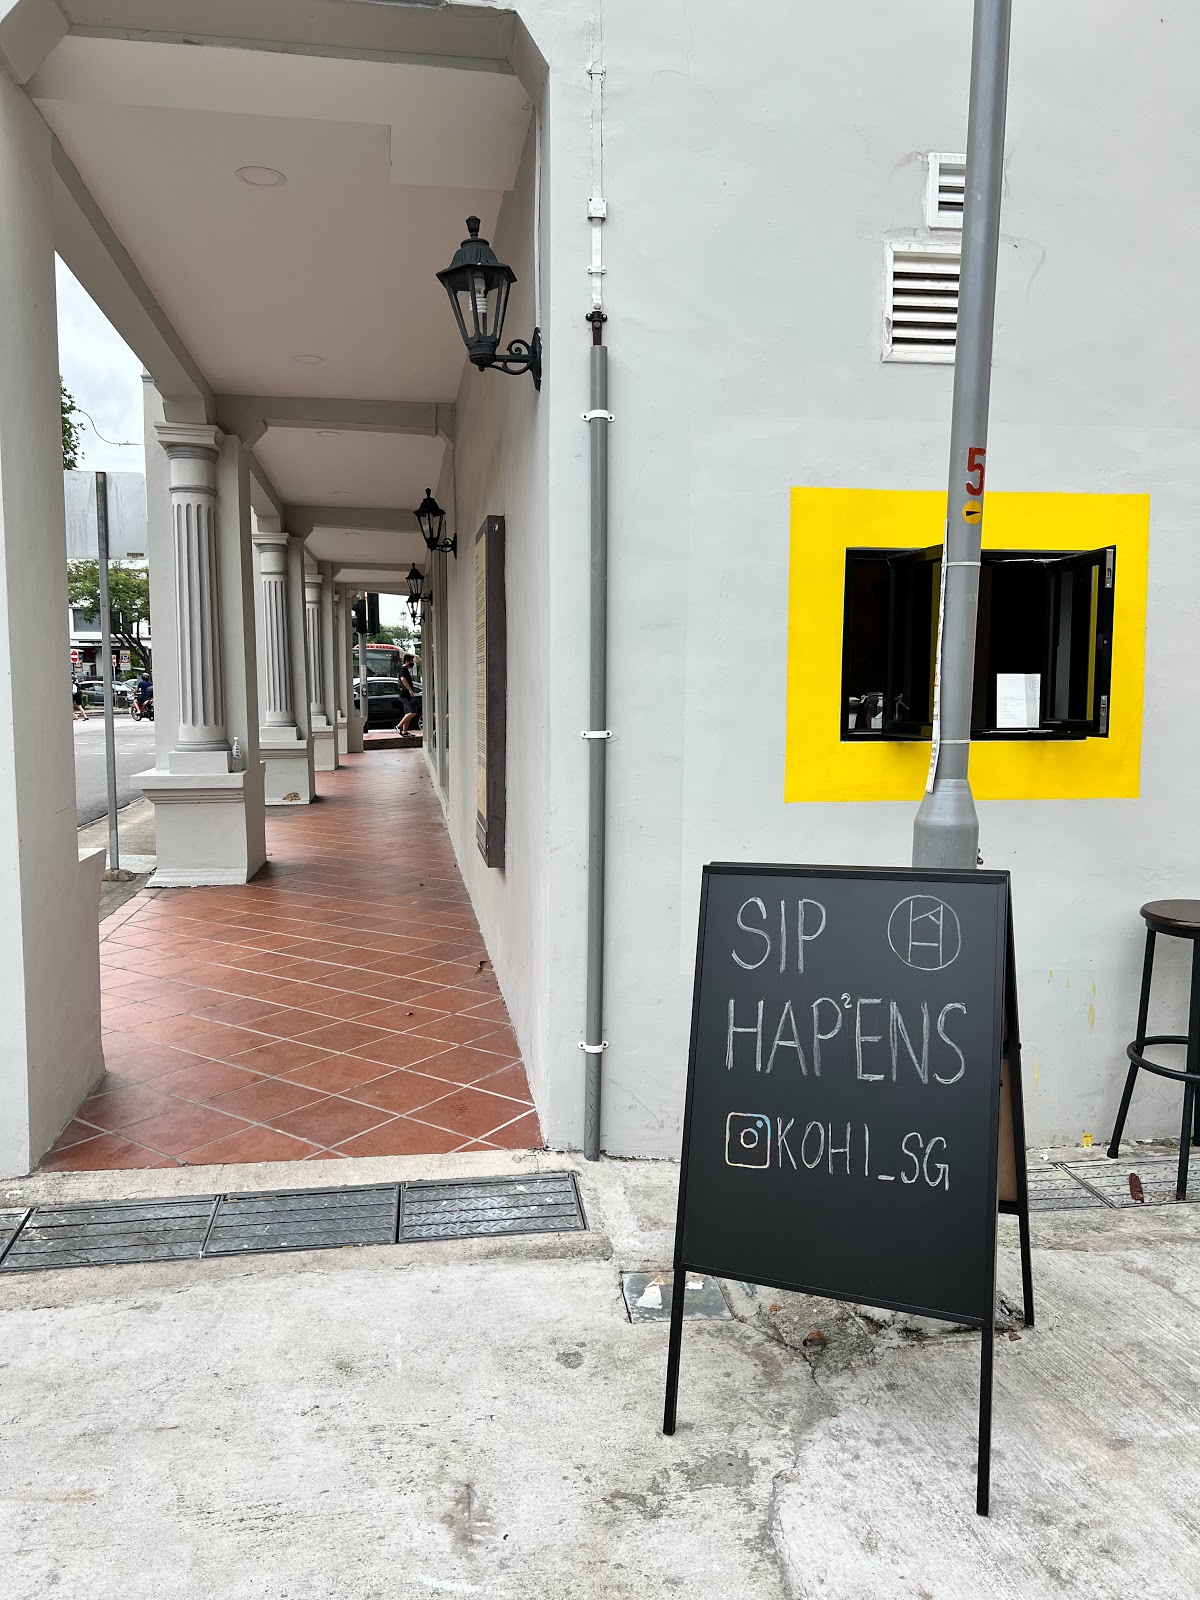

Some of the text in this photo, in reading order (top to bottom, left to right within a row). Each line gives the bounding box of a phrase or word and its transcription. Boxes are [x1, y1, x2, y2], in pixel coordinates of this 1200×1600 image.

[965, 447, 987, 497] 5
[731, 896, 827, 974] SIP
[776, 1116, 950, 1191] KOHI_SG
